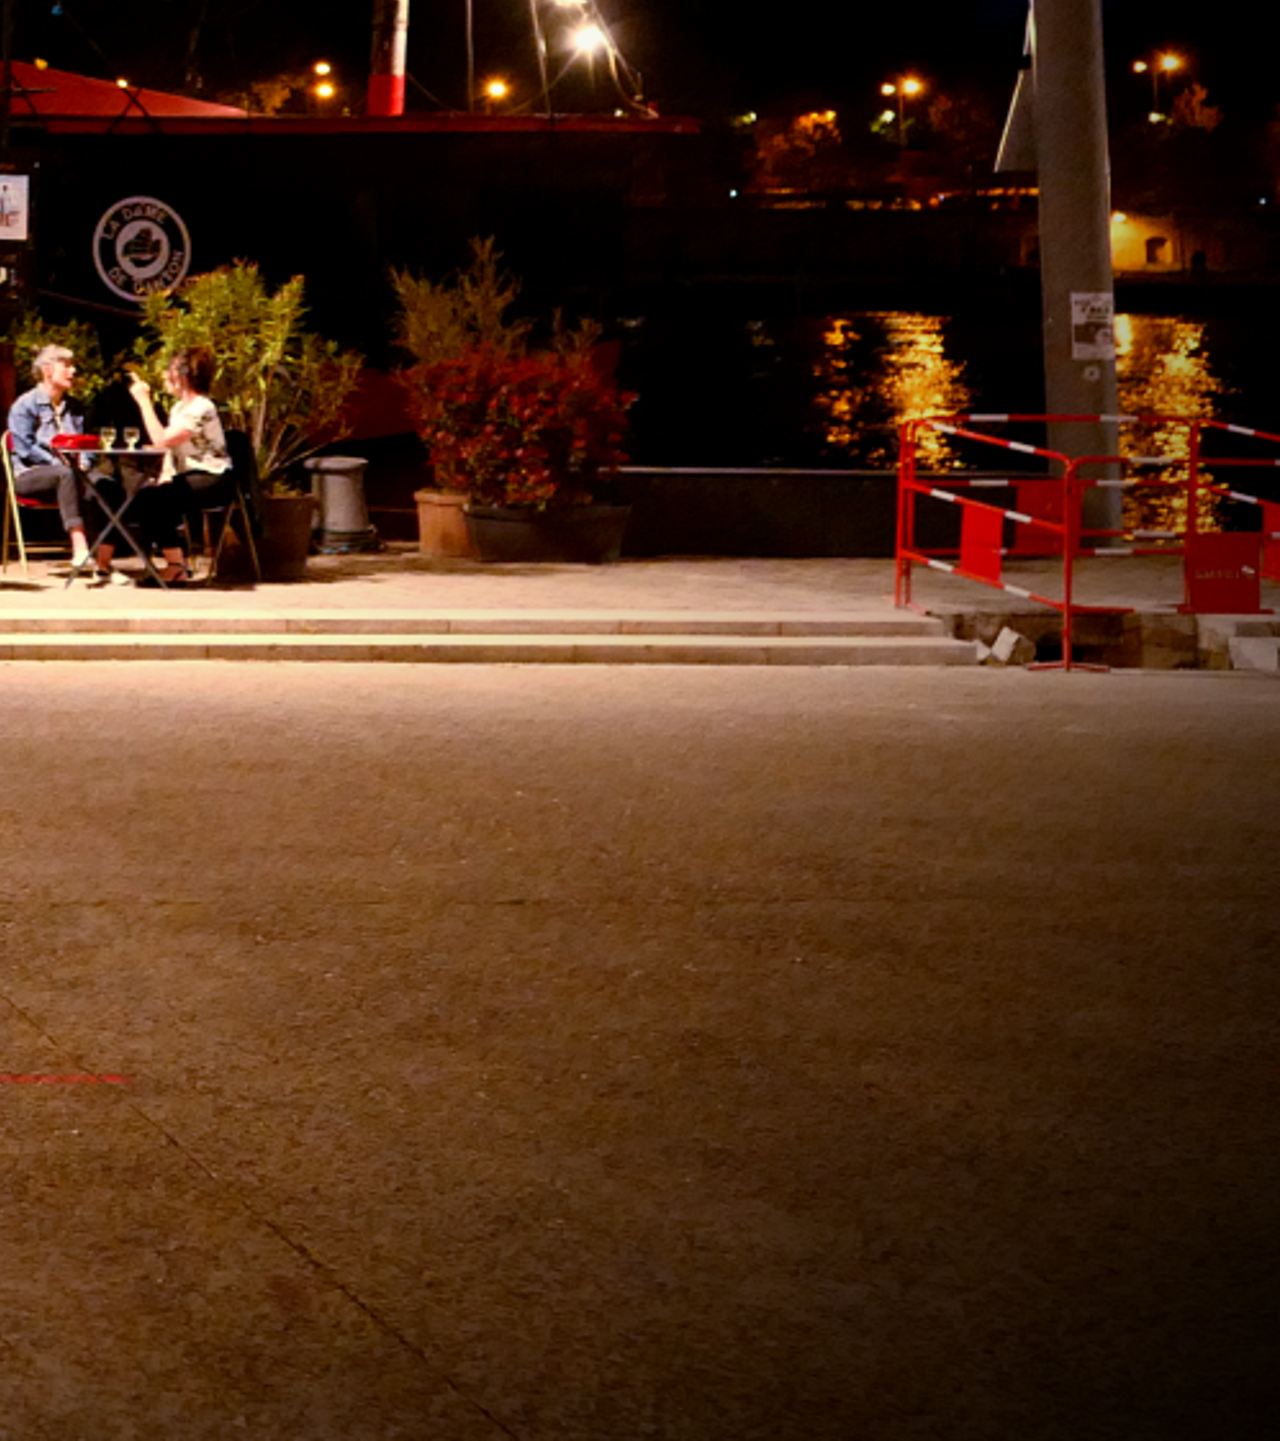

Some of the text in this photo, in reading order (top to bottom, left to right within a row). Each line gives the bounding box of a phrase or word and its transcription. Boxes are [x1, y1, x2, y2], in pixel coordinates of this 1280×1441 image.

[101, 204, 168, 240] LA DAME
[108, 266, 129, 289] DE
